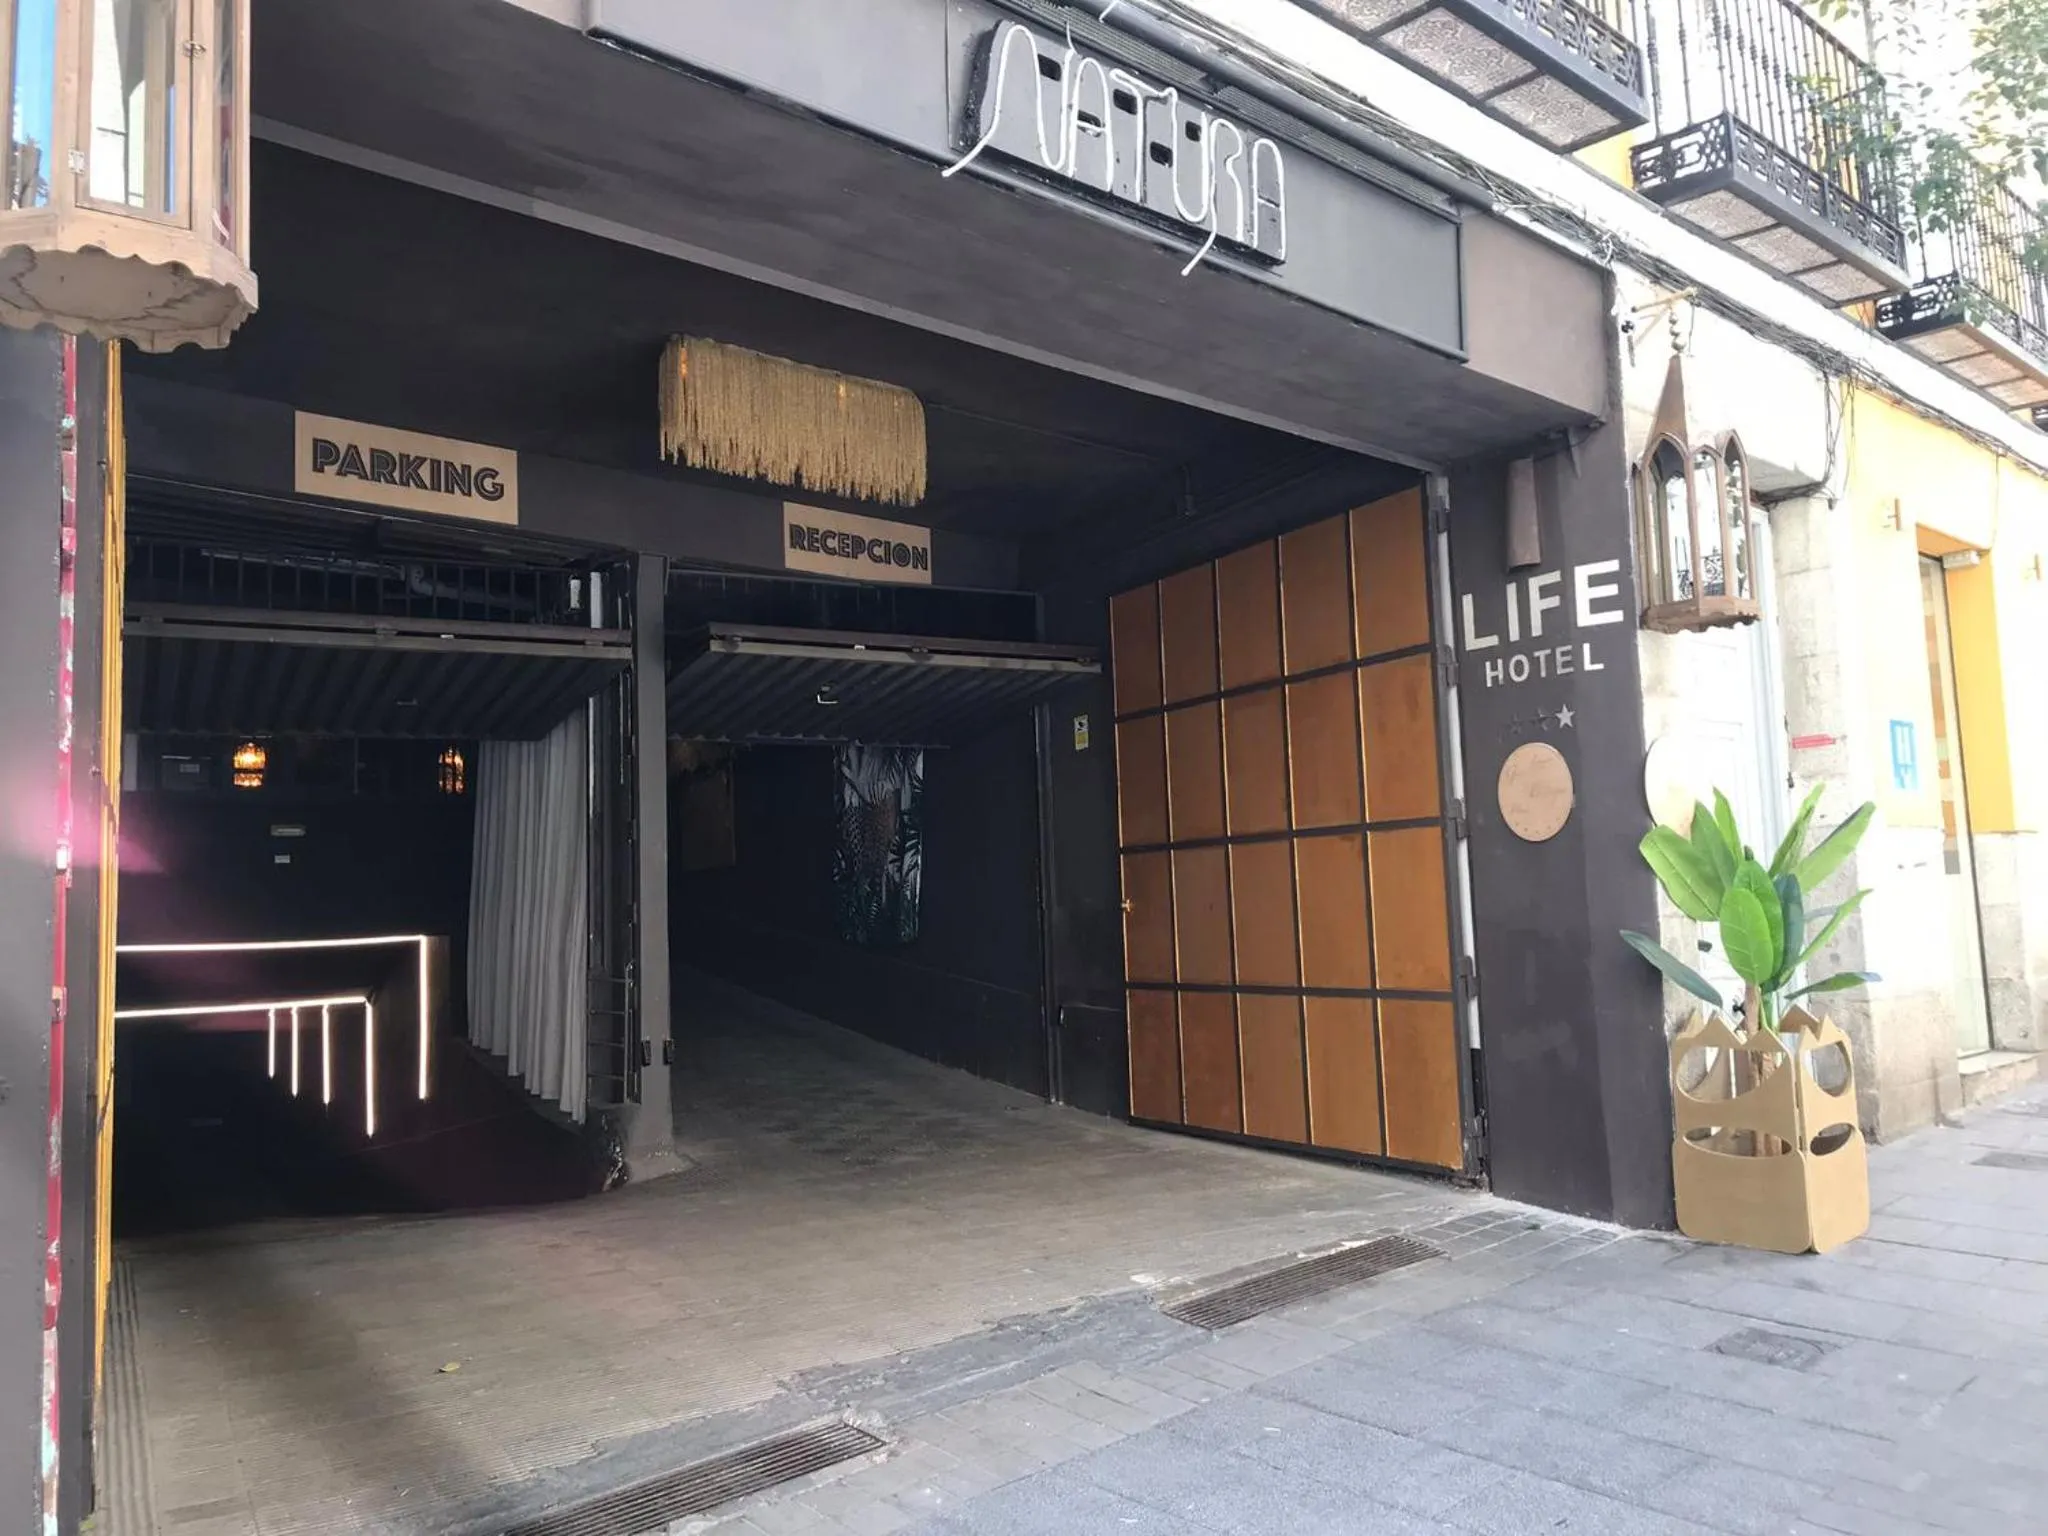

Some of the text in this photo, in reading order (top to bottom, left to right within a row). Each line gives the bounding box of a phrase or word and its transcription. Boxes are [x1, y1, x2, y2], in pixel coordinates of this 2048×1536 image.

[942, 23, 1286, 276] NATURA
[312, 437, 505, 501] PARKING
[789, 523, 928, 571] RECEPCION
[1462, 559, 1624, 651] LIFE
[1485, 643, 1604, 687] HOTEL
